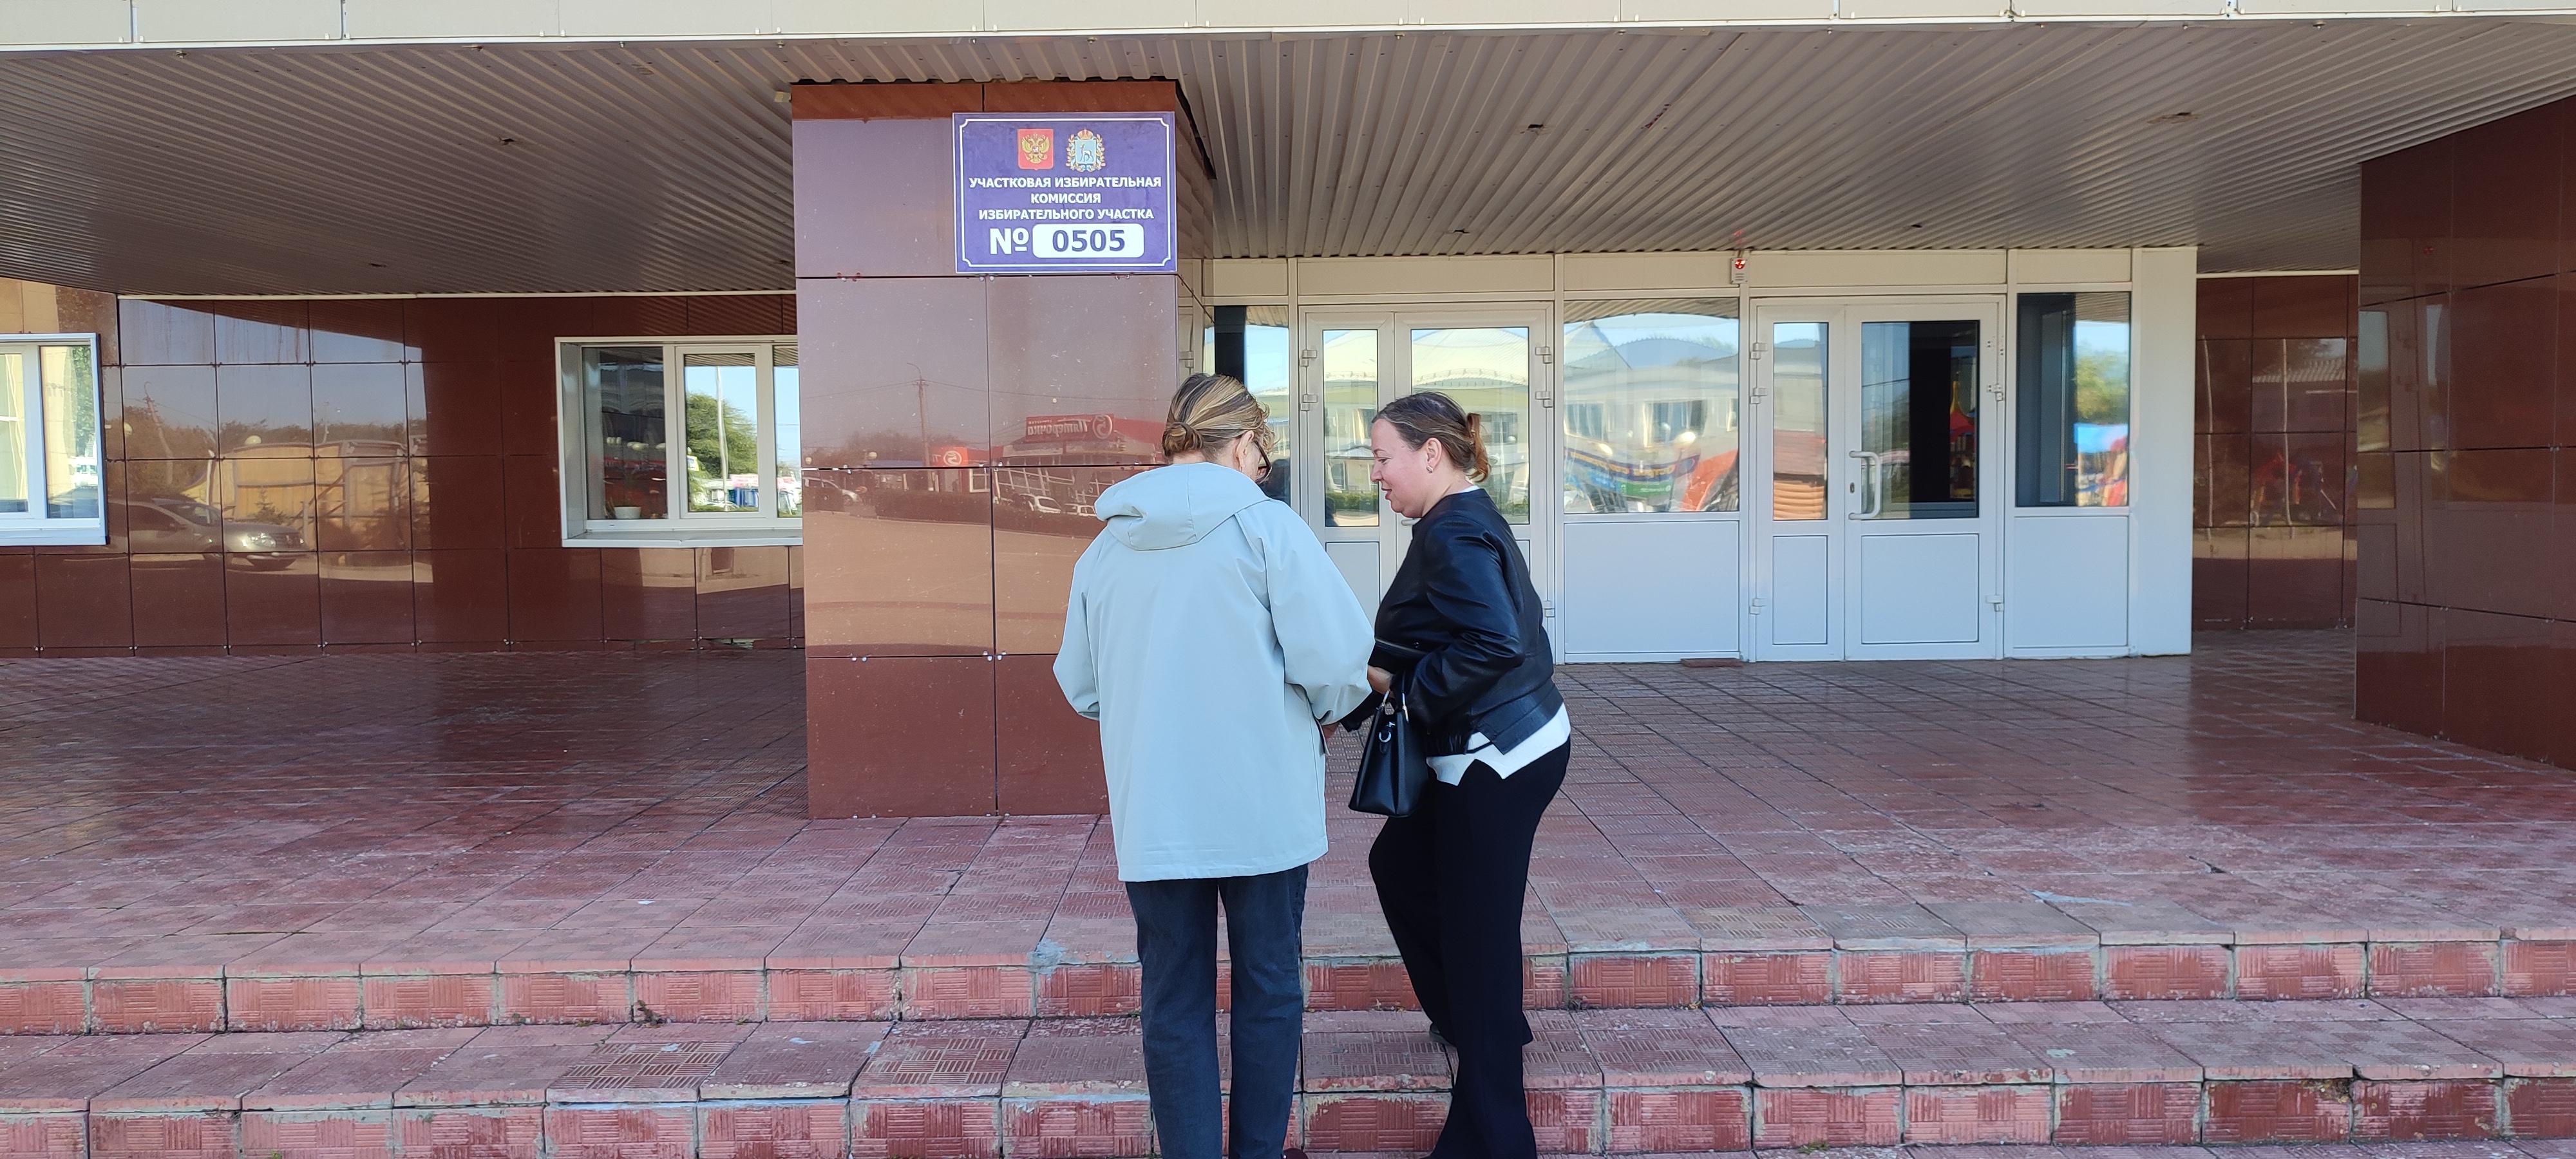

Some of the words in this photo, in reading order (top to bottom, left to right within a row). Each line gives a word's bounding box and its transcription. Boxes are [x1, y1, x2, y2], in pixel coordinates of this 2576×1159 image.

[969, 177, 1051, 189] УЧАСТКОВАЯ
[1054, 176, 1162, 187] ИЗБИРАТЕЛЬНАЯ
[1030, 193, 1101, 203] КОМИССИЯ
[979, 209, 1095, 220] ИЗБИРАТЕЛЬНОГО
[1097, 209, 1155, 220] УЧАСТКА
[989, 227, 1029, 254] №
[1052, 229, 1126, 252] 0505
